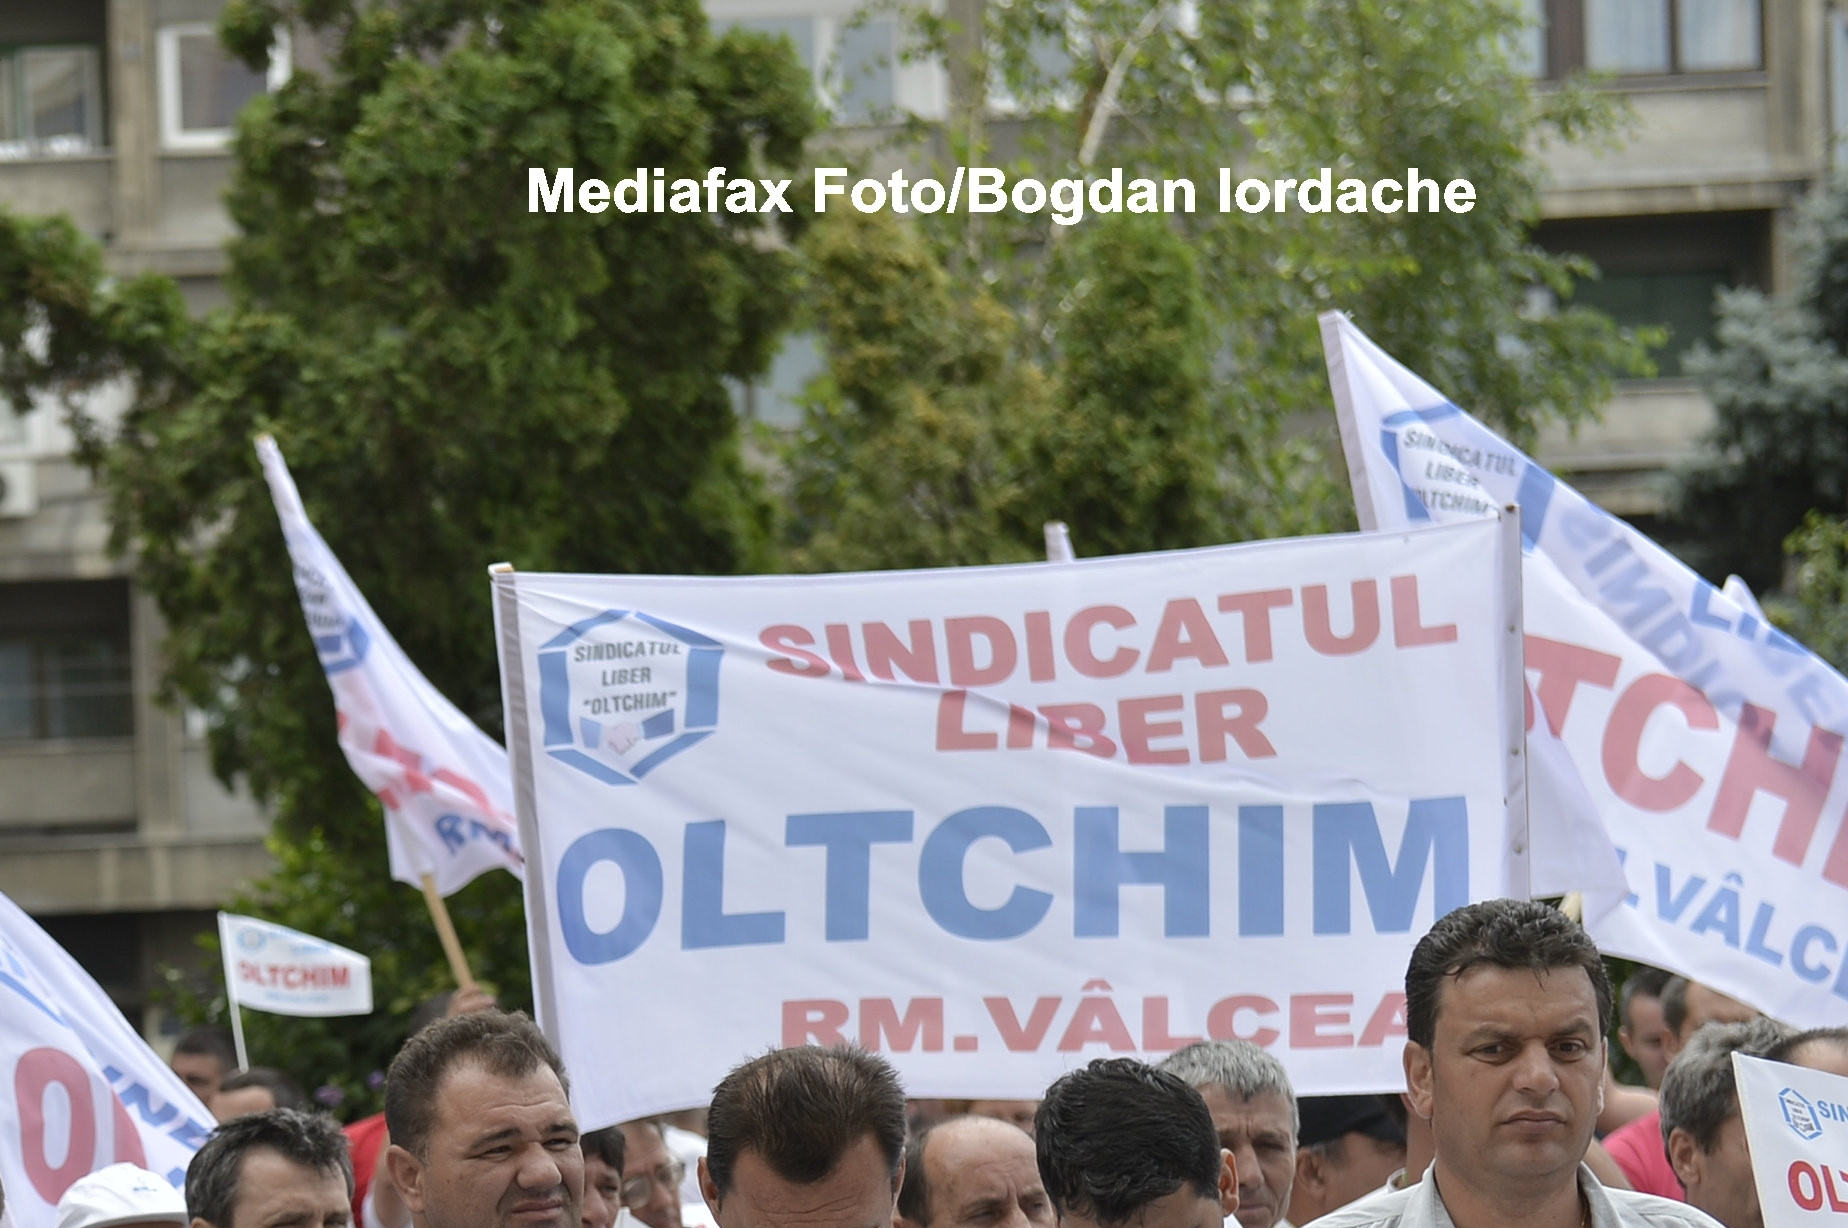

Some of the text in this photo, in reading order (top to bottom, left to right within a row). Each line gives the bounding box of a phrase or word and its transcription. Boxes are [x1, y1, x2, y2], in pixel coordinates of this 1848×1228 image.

[574, 641, 682, 663] SINDICATUL
[758, 573, 1459, 687] SINDICATUL
[601, 667, 652, 687] LIBER
[934, 686, 1278, 766] LIBER
[556, 795, 1470, 967] OLTCHIM
[779, 977, 1409, 1054] RM.VÂLCEA
